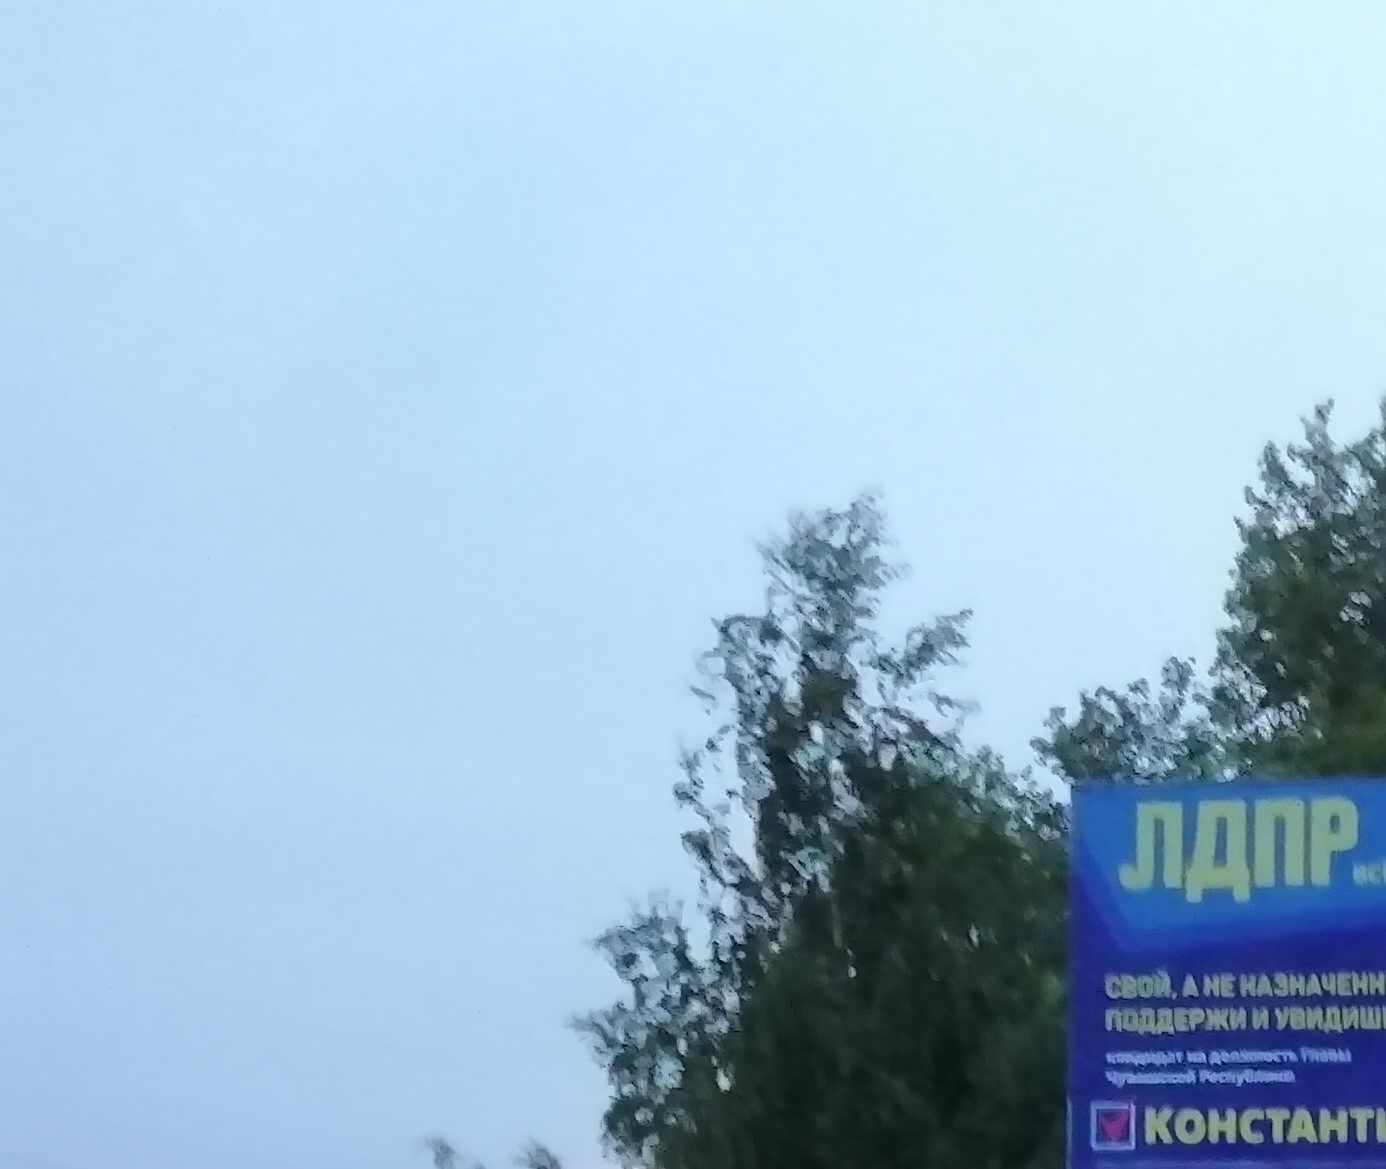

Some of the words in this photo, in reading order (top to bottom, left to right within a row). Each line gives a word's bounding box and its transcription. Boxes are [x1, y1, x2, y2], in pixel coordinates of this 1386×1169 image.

[1118, 797, 1359, 903] ЛДПР
[1104, 969, 1178, 1000] СВОЙ,
[1182, 973, 1200, 998] А
[1203, 972, 1236, 998] НЕ
[1105, 1007, 1247, 1036] ПОДДЕРЖИ
[1252, 1006, 1269, 1031] И
